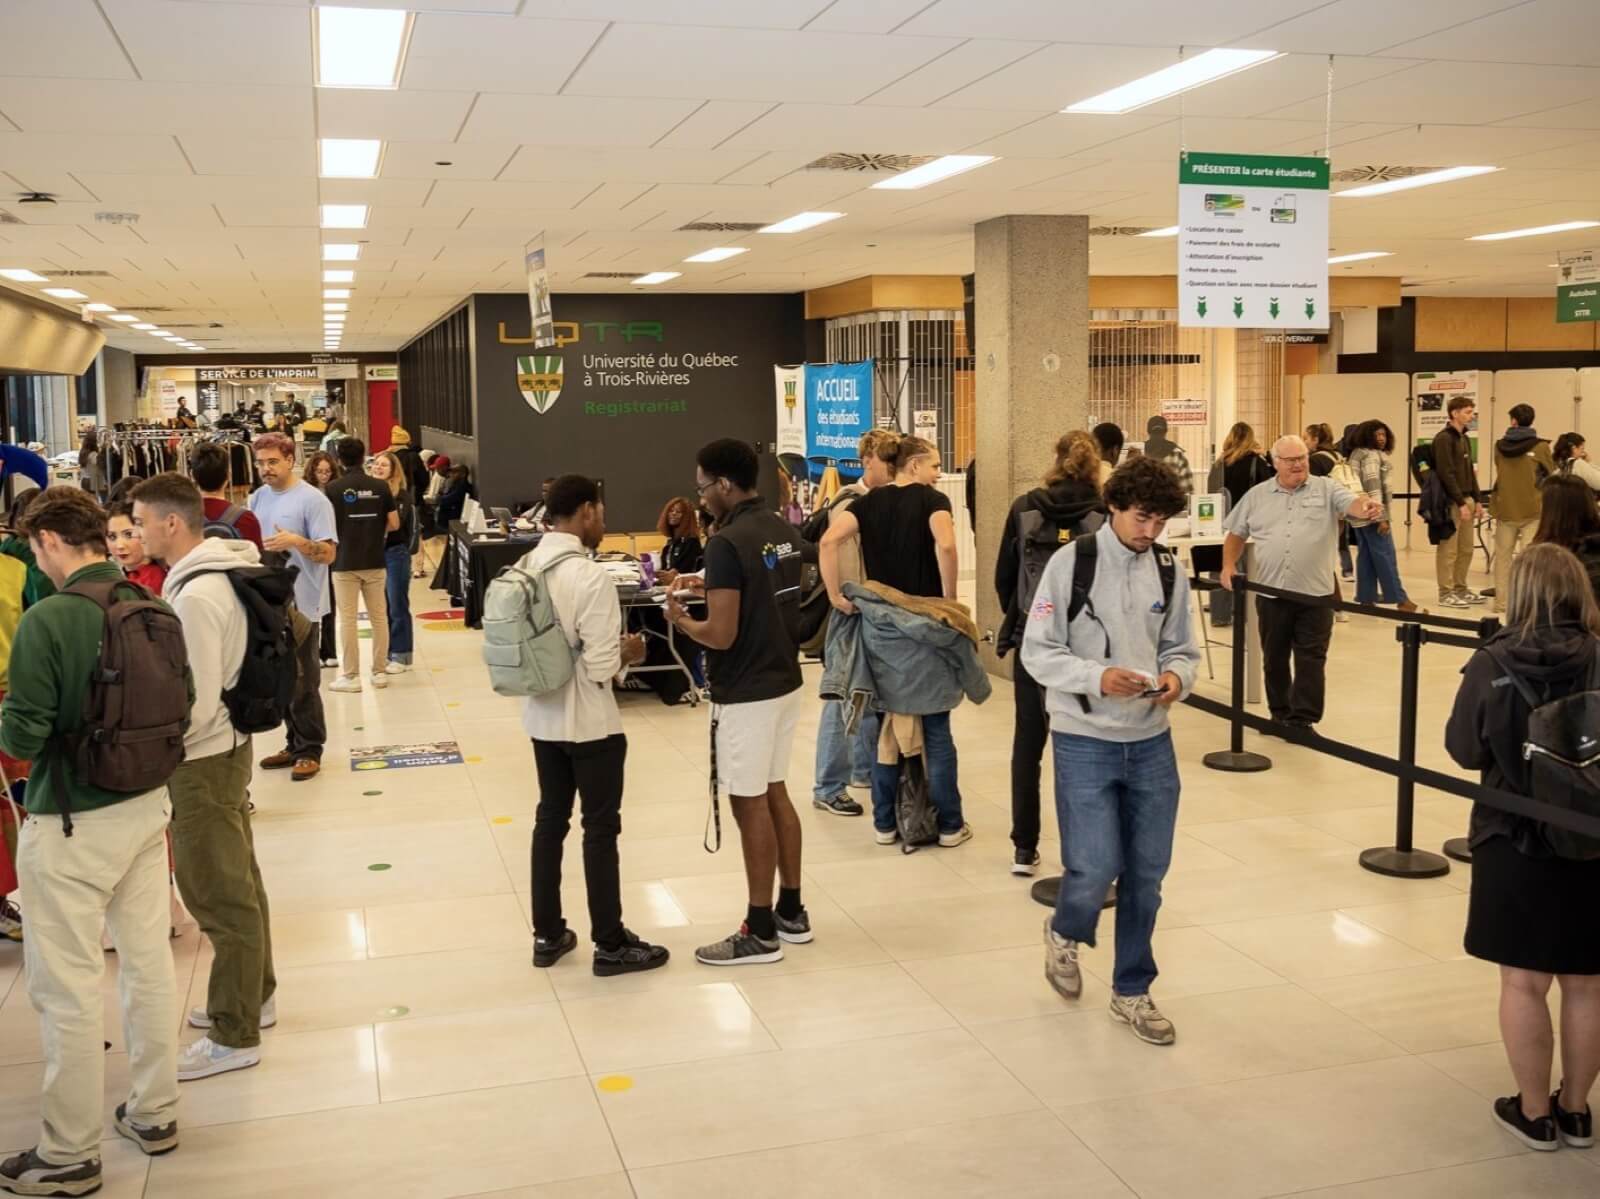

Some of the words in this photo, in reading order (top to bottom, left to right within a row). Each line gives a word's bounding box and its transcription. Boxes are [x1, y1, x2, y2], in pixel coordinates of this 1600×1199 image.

[1192, 163, 1241, 175] PRÉSENTER
[1242, 166, 1250, 175] la
[1252, 168, 1274, 177] carte
[1275, 167, 1317, 178] étudiante
[1189, 253, 1224, 261] Attestation
[1189, 280, 1216, 288] Question
[583, 353, 655, 369] Université
[658, 353, 678, 368] du
[682, 352, 739, 370] Québec
[200, 369, 247, 380] SERVICE
[250, 369, 265, 379] DE
[267, 369, 319, 379] L'IMPRIM
[583, 372, 593, 387] à
[597, 371, 691, 387] Trois-Rivières
[816, 378, 860, 402] ACCUEIL
[585, 400, 688, 417] Registrariat
[817, 407, 829, 425] des
[829, 408, 860, 425] étudiants
[815, 431, 859, 449] internationau
